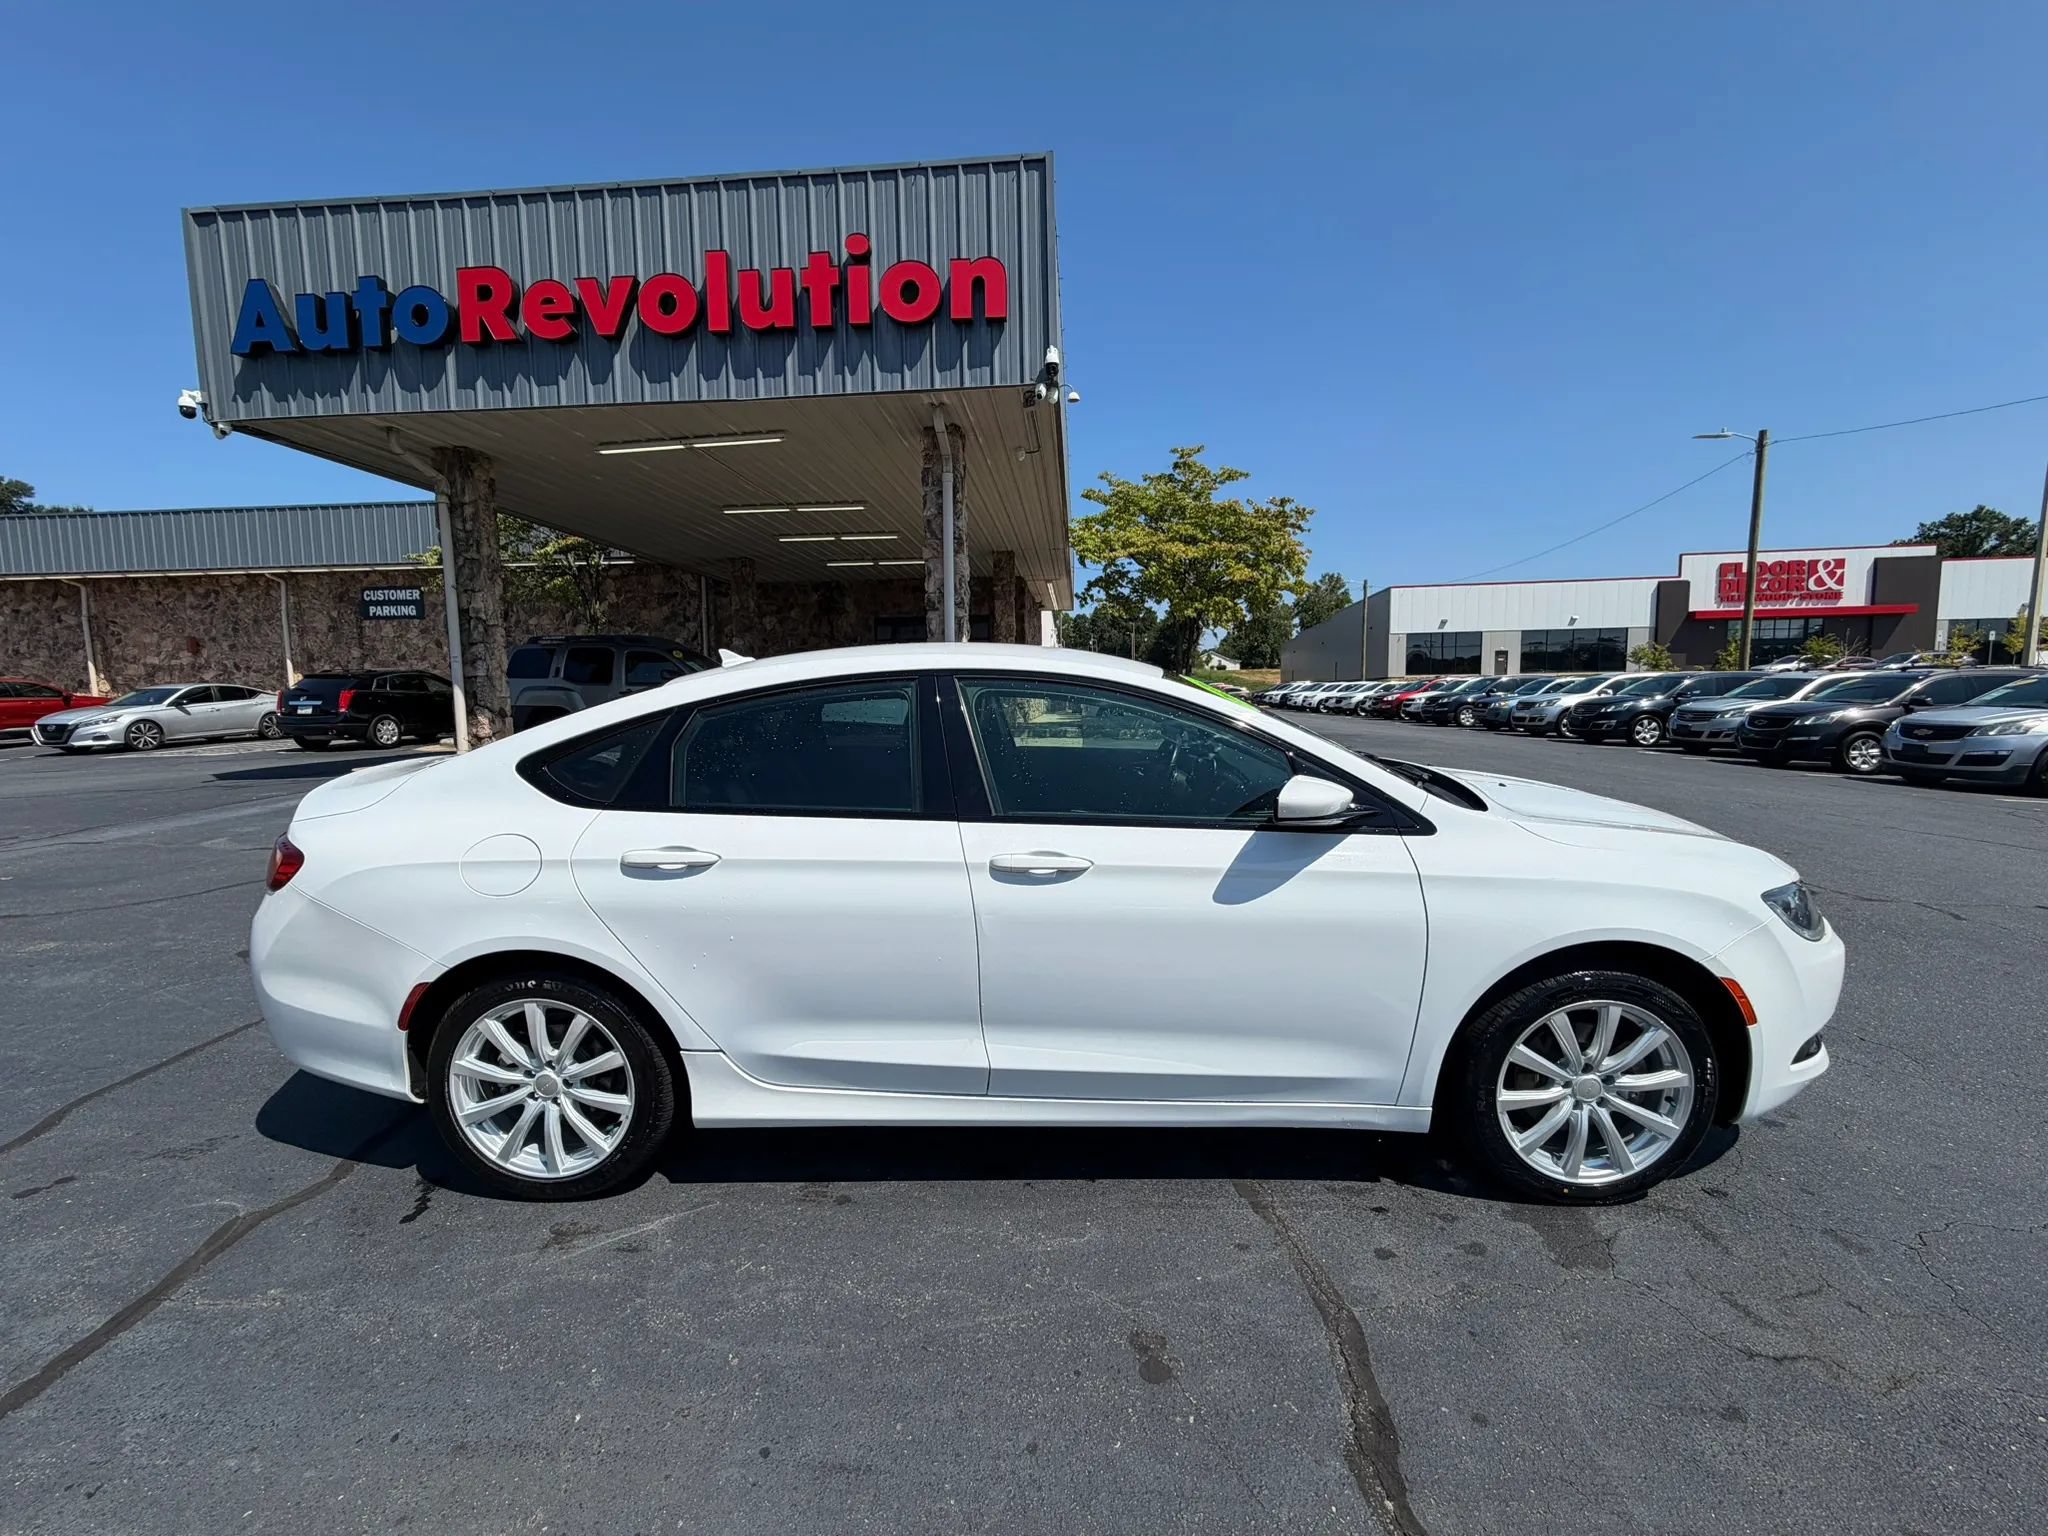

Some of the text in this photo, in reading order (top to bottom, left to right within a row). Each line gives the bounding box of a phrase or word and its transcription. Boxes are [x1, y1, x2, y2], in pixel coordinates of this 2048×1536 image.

[1720, 560, 1807, 578] FLOOR
[1808, 559, 1845, 591] &
[363, 589, 420, 601] CUSTOMER
[369, 605, 417, 617] PARKING
